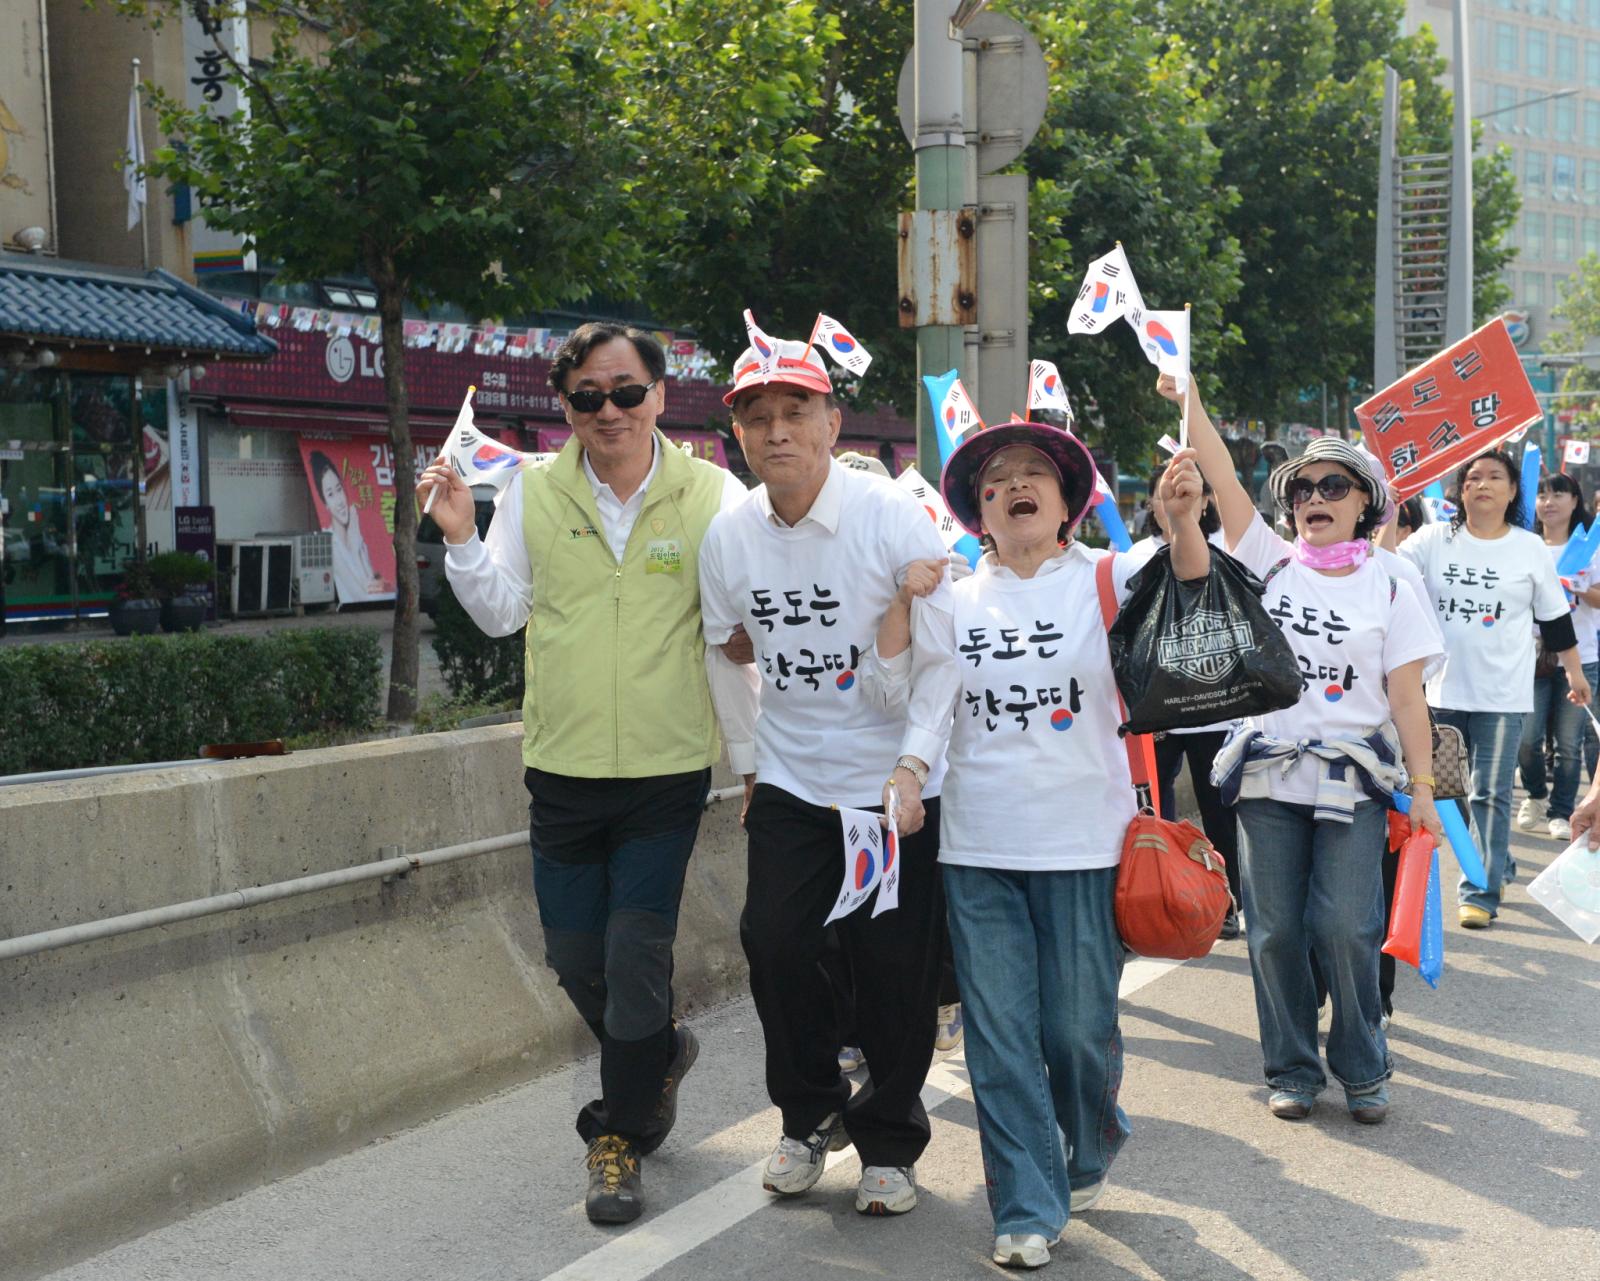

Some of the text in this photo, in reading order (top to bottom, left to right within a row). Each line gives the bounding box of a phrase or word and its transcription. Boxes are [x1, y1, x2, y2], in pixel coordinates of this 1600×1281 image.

[1442, 563, 1500, 590] 독도는
[751, 583, 840, 633] 독도는
[1181, 616, 1223, 636] MOTOR
[1269, 594, 1351, 646] 독도는
[1438, 596, 1506, 628] 한국땅
[959, 620, 1064, 668] 독도는
[761, 644, 863, 691] 한국땅
[1186, 653, 1231, 677] CYCLES
[965, 676, 1085, 732] 한국땅
[1163, 689, 1228, 705] HARLEY-DAVIDSON
[1230, 686, 1240, 694] OF
